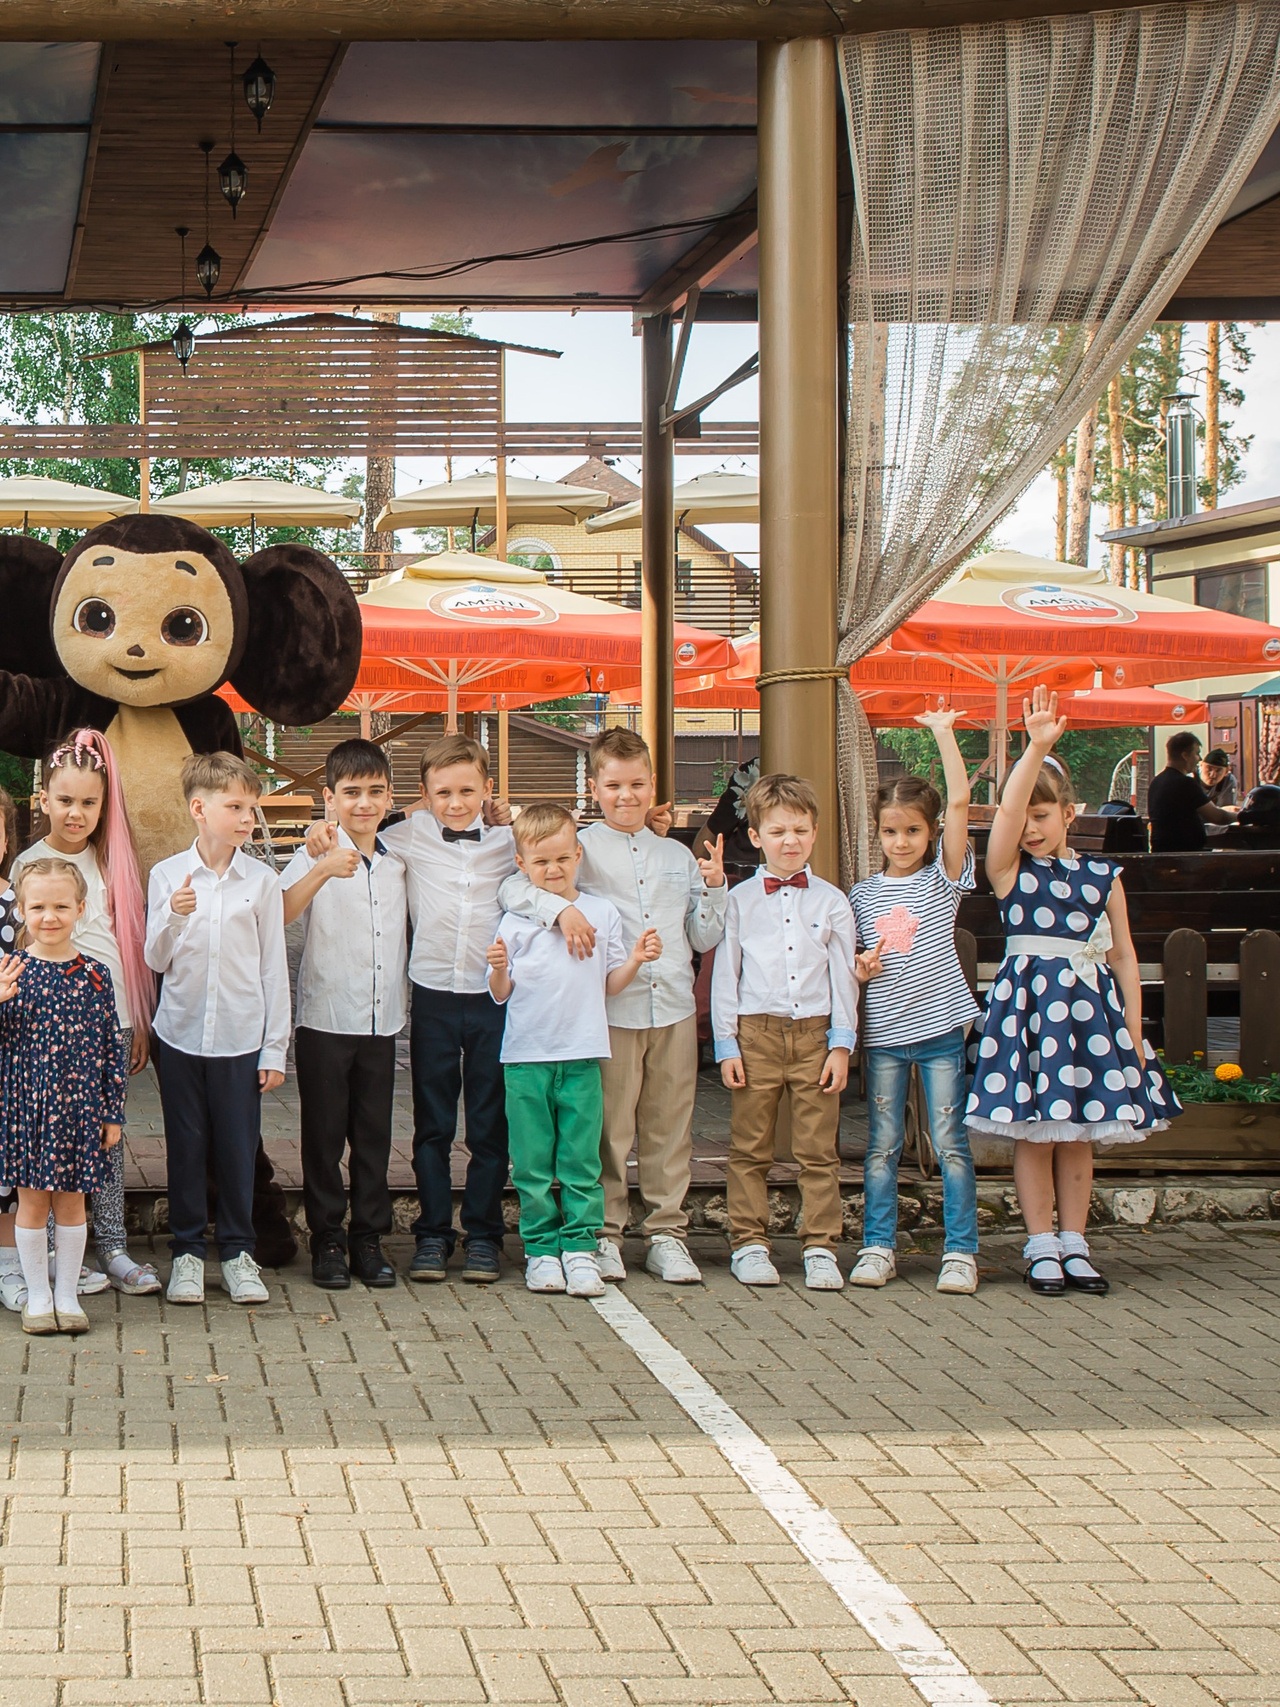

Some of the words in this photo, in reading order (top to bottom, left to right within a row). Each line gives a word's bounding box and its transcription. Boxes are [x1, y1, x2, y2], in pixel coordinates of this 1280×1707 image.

[455, 598, 530, 608] AMSTEL
[1029, 597, 1105, 608] AMSTEL
[478, 605, 515, 613] BIER
[1057, 604, 1095, 612] BIER
[926, 632, 937, 641] 18
